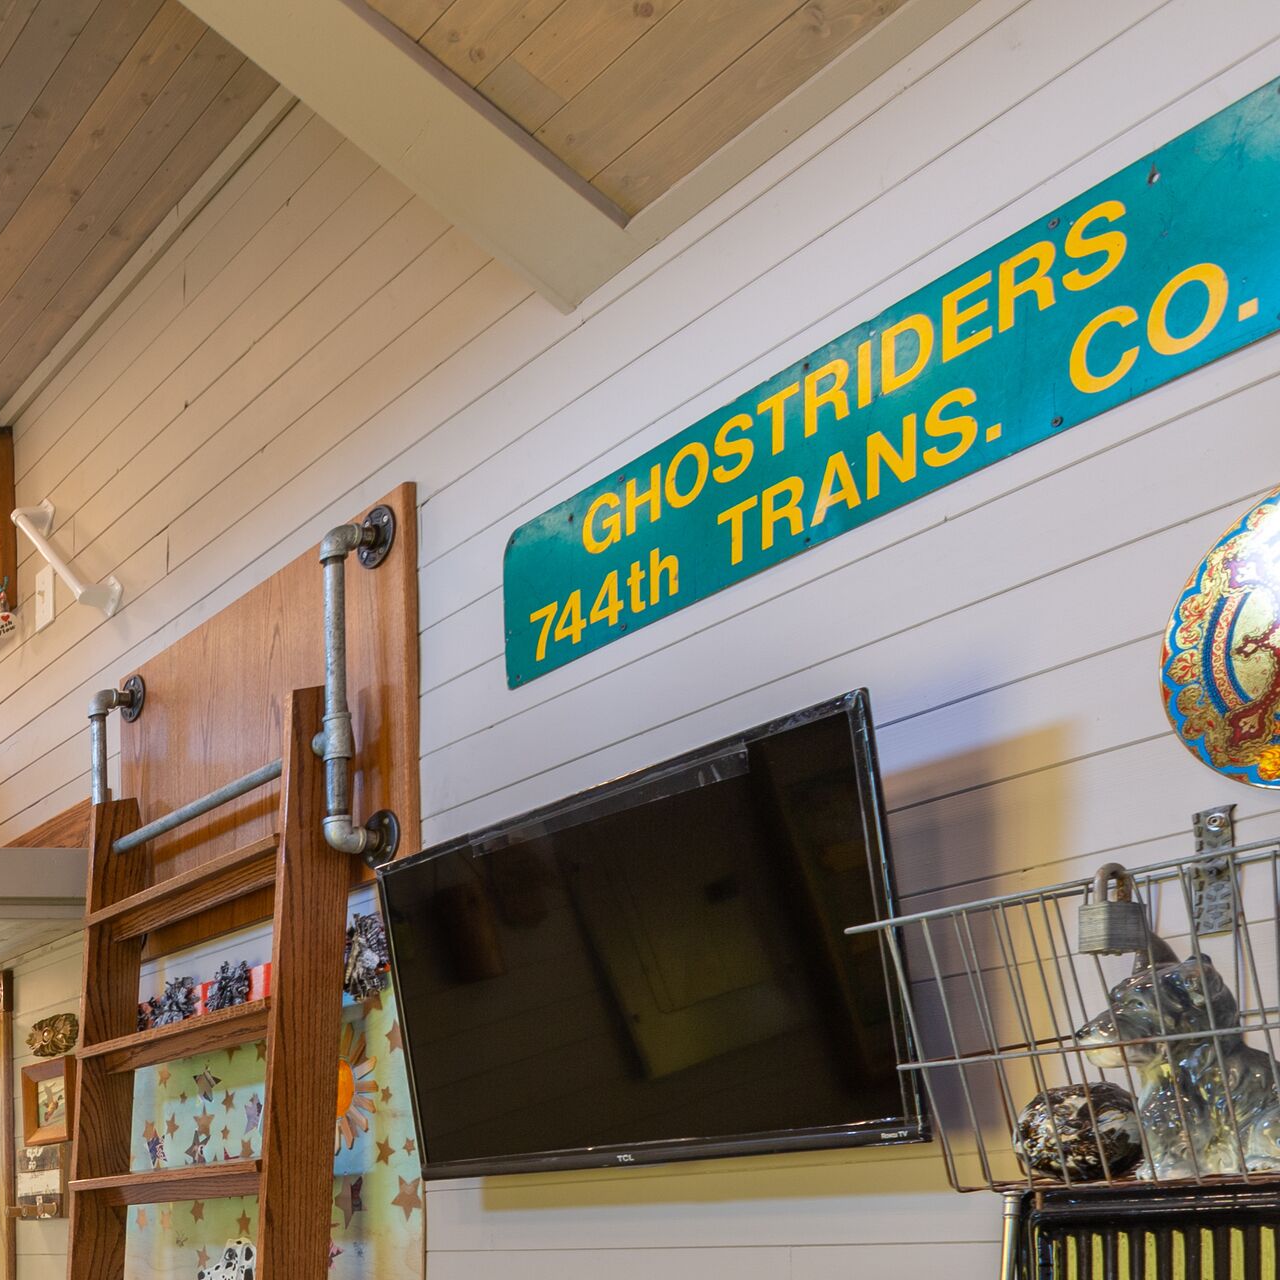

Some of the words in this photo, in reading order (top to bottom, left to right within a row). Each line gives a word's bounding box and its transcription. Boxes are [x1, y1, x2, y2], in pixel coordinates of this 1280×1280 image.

[529, 547, 679, 663] 744th
[717, 387, 1002, 565] TRANS.
[1069, 262, 1258, 393] CO.
[582, 200, 1127, 554] GHOSTRIDERS
[616, 1153, 635, 1162] TCL
